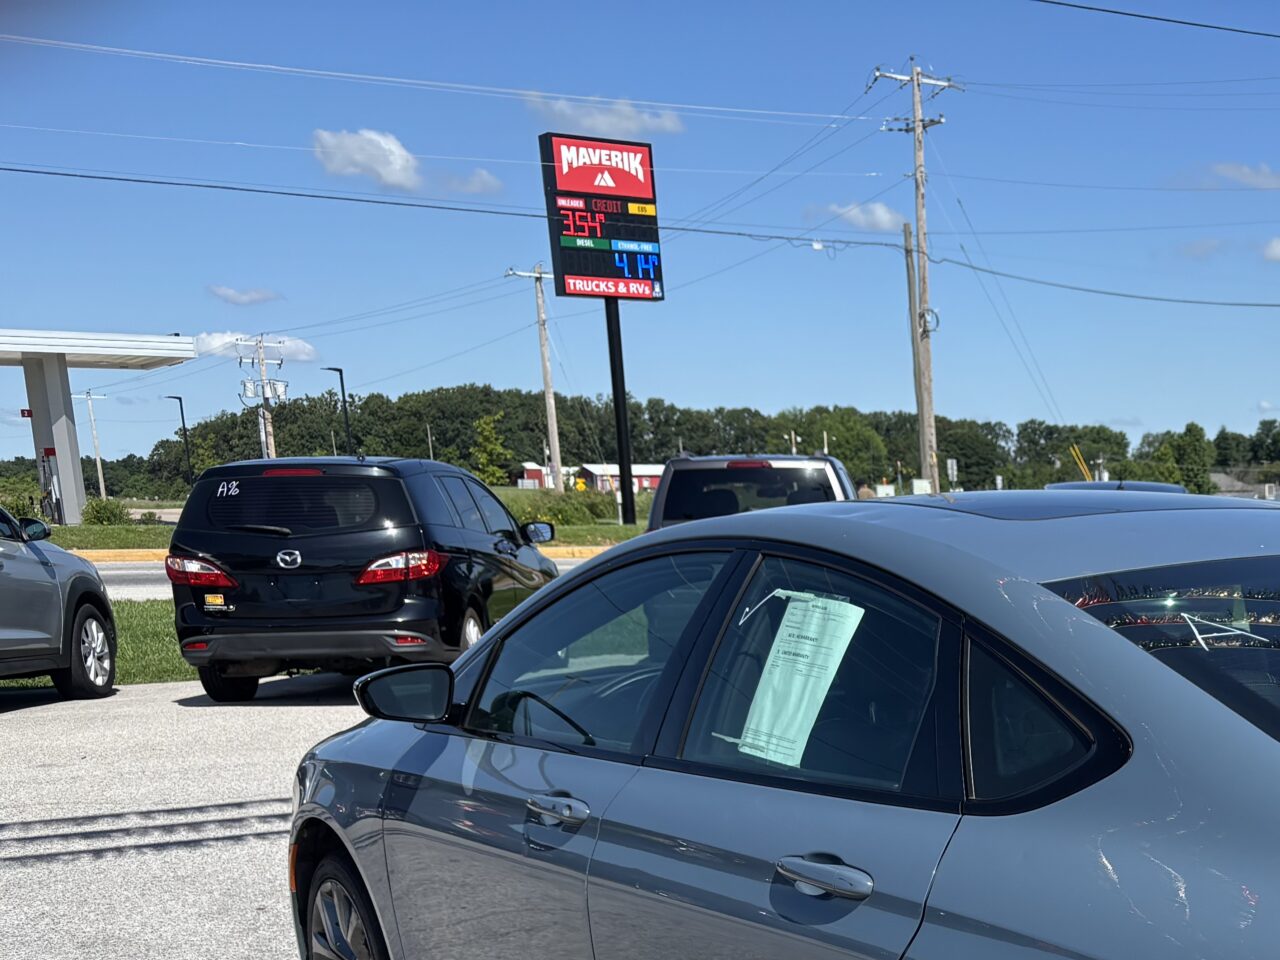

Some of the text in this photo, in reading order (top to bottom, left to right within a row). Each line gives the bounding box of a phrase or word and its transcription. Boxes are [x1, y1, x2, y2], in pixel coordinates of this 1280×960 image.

[560, 144, 645, 184] MAVERIK
[591, 198, 622, 213] CREDIT
[576, 238, 595, 248] DIESEL
[567, 278, 615, 293] TRUCKS
[617, 281, 628, 292] &
[629, 283, 651, 295] RVs
